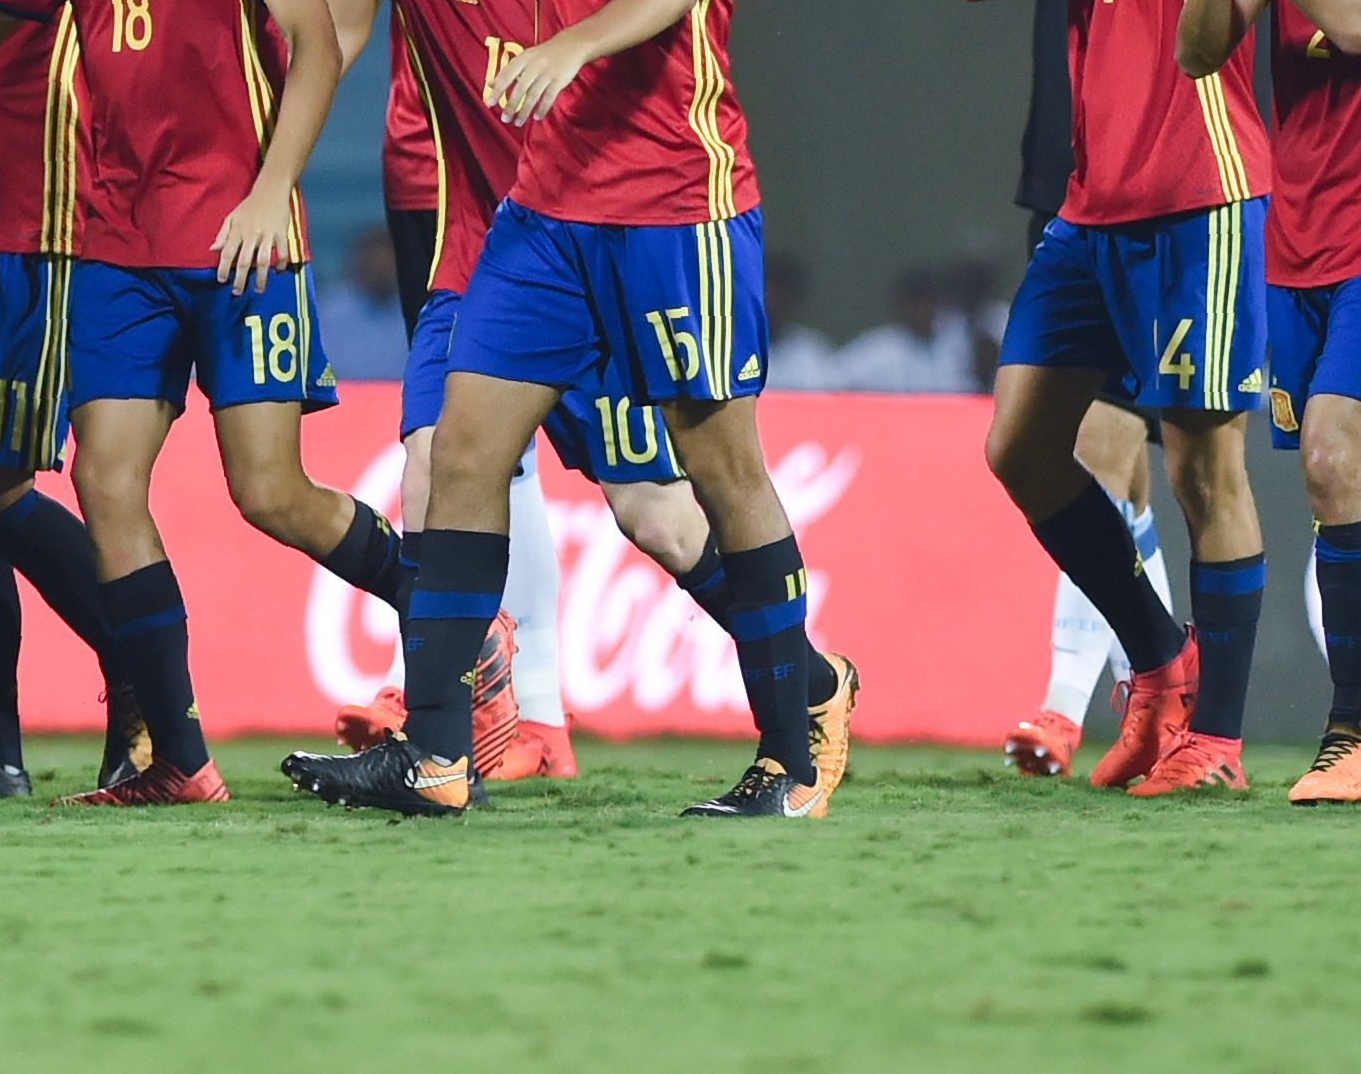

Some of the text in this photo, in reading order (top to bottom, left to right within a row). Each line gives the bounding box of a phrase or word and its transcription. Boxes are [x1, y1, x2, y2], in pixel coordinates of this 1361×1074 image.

[245, 313, 297, 384] 18
[645, 307, 700, 382] 15
[1154, 319, 1195, 390] 4
[595, 396, 658, 466] 10
